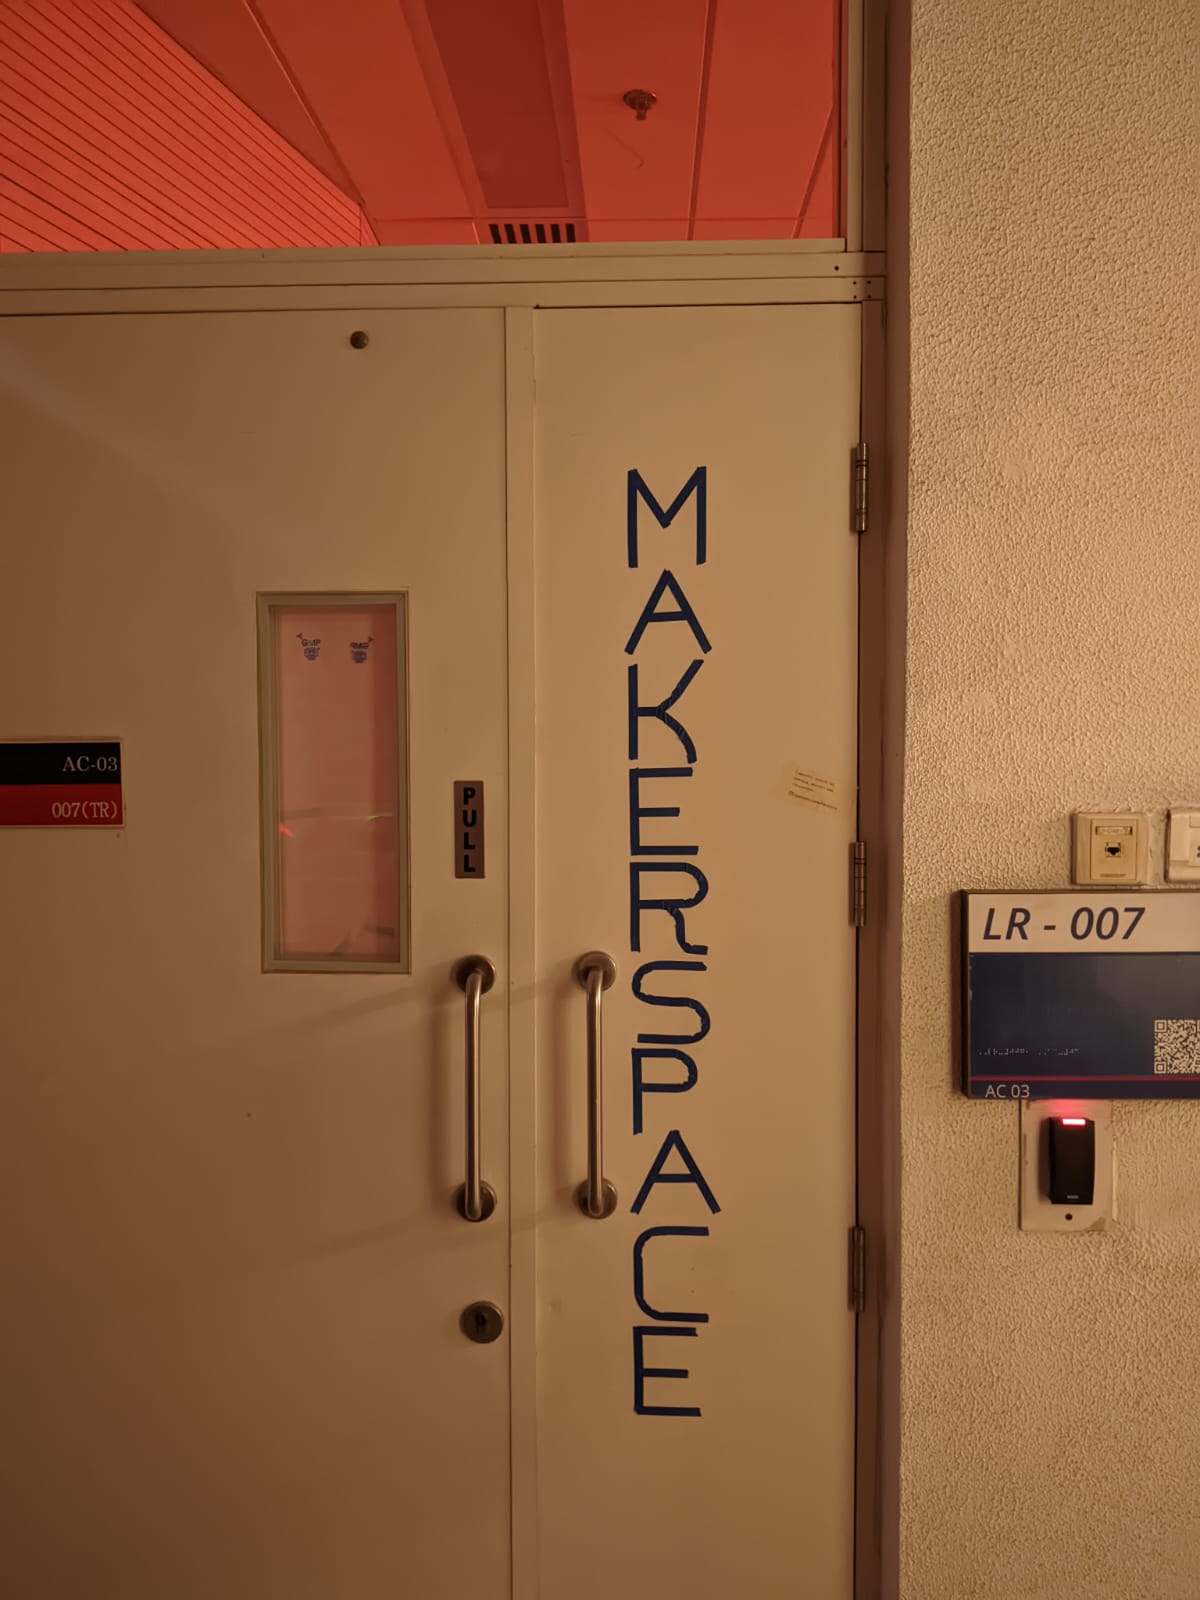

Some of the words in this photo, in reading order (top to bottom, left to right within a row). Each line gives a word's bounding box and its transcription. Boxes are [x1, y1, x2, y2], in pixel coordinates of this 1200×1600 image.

[62, 755, 118, 772] AC-03
[51, 801, 118, 819] 007(TR)
[462, 787, 477, 873] PULL
[983, 908, 1031, 940] LR
[1070, 907, 1146, 940] 007
[624, 466, 721, 1417] MAKERSPACE
[985, 1084, 1007, 1098] AC
[1010, 1084, 1030, 1098] 03
